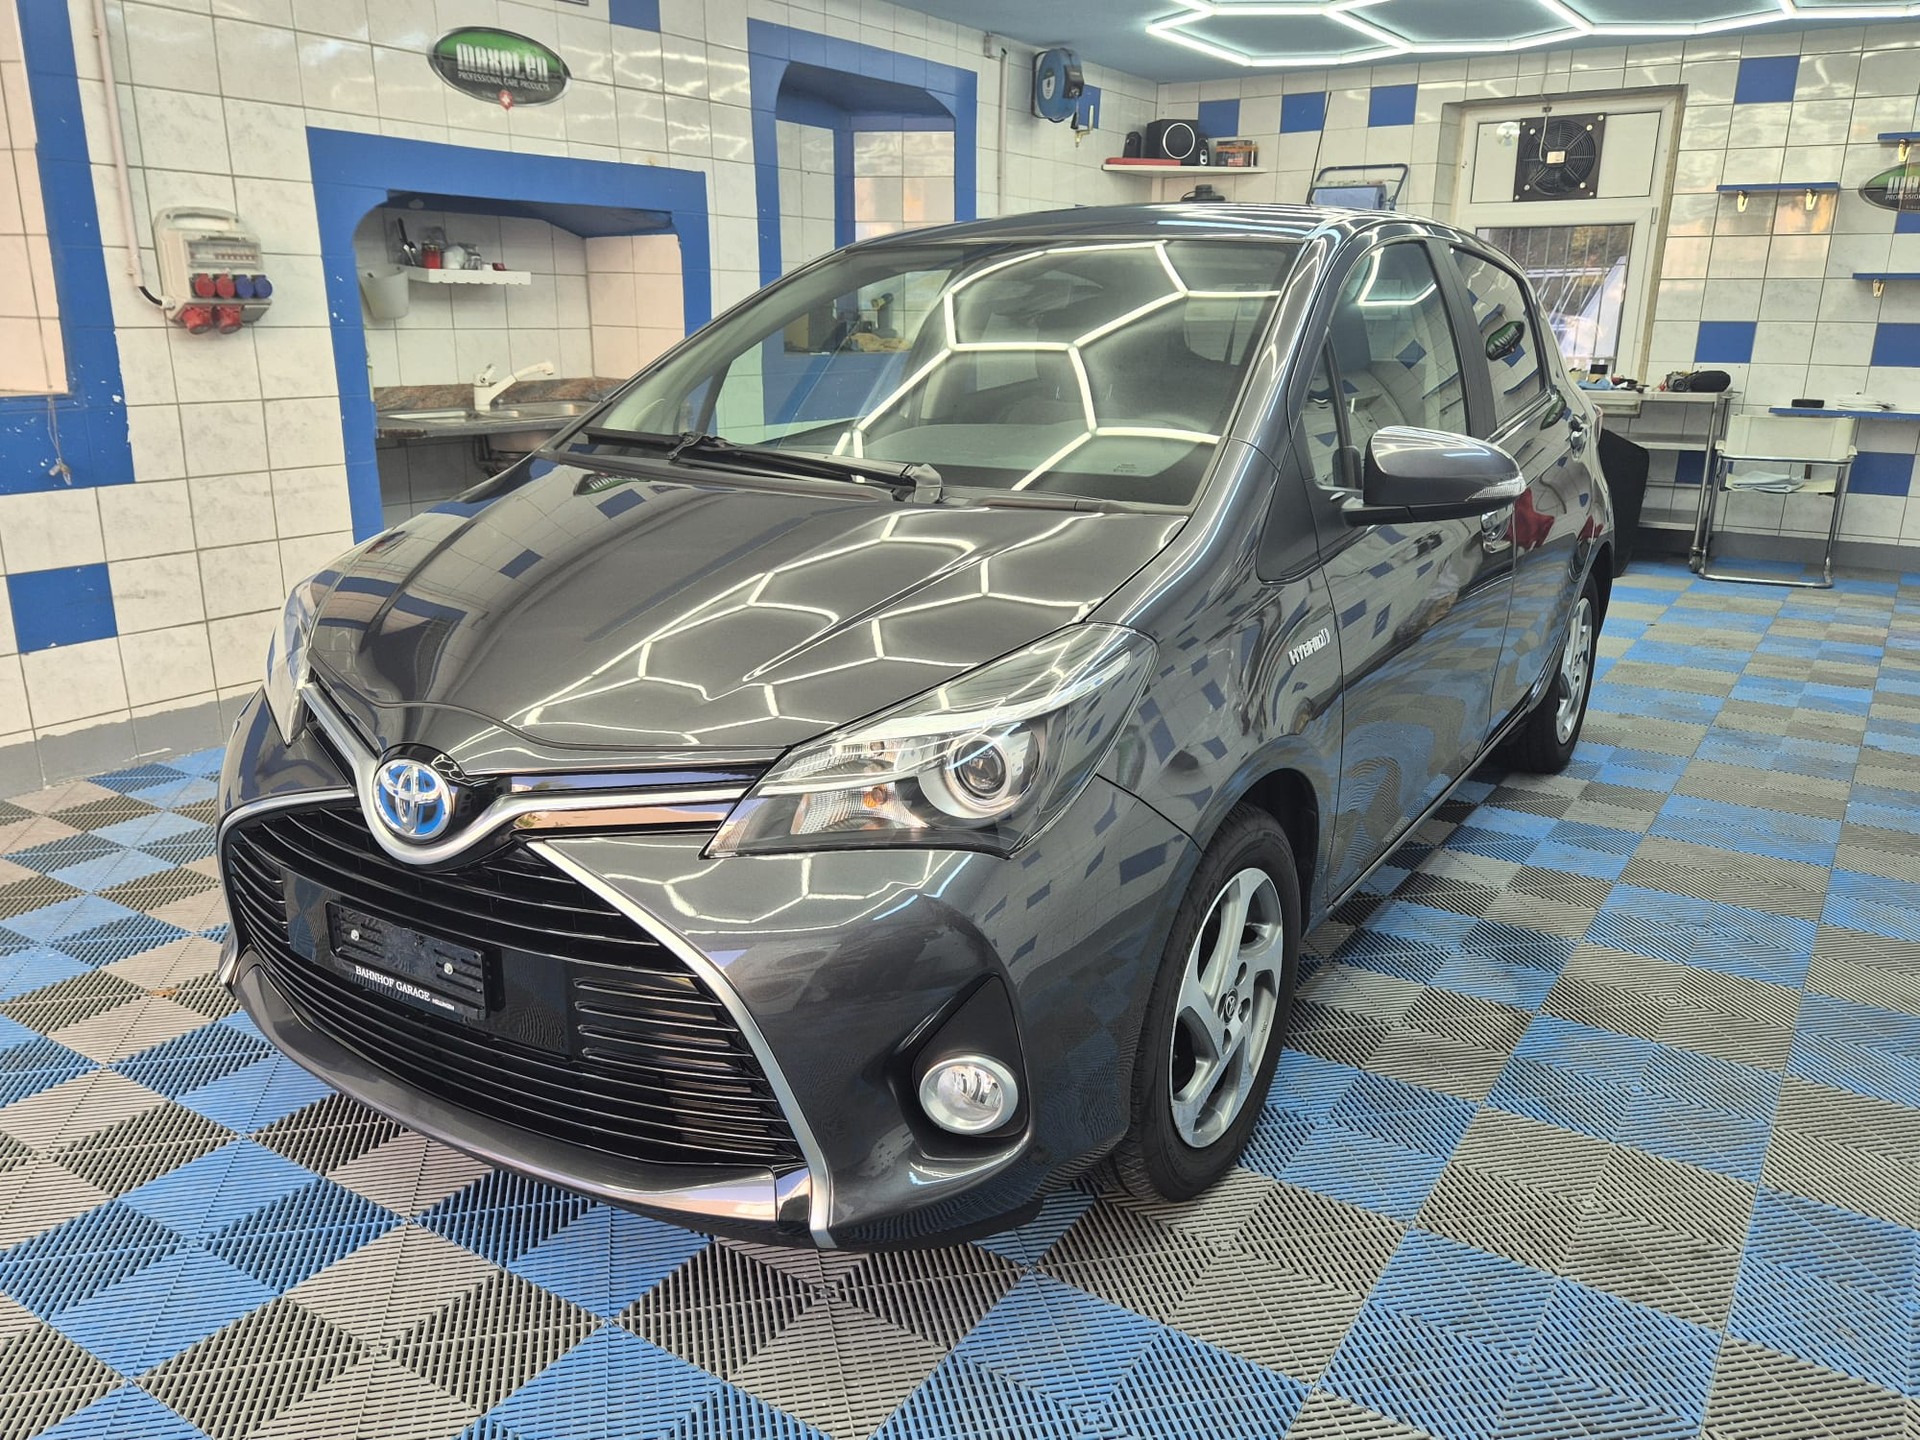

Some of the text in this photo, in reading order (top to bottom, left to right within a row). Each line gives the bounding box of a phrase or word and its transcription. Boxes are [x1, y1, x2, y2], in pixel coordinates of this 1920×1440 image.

[458, 71, 550, 91] PROFESSIONAL CARE PRODUCTS
[1288, 627, 1330, 666] HYBRID
[355, 965, 430, 1001] BAHNHOF GARAGE
